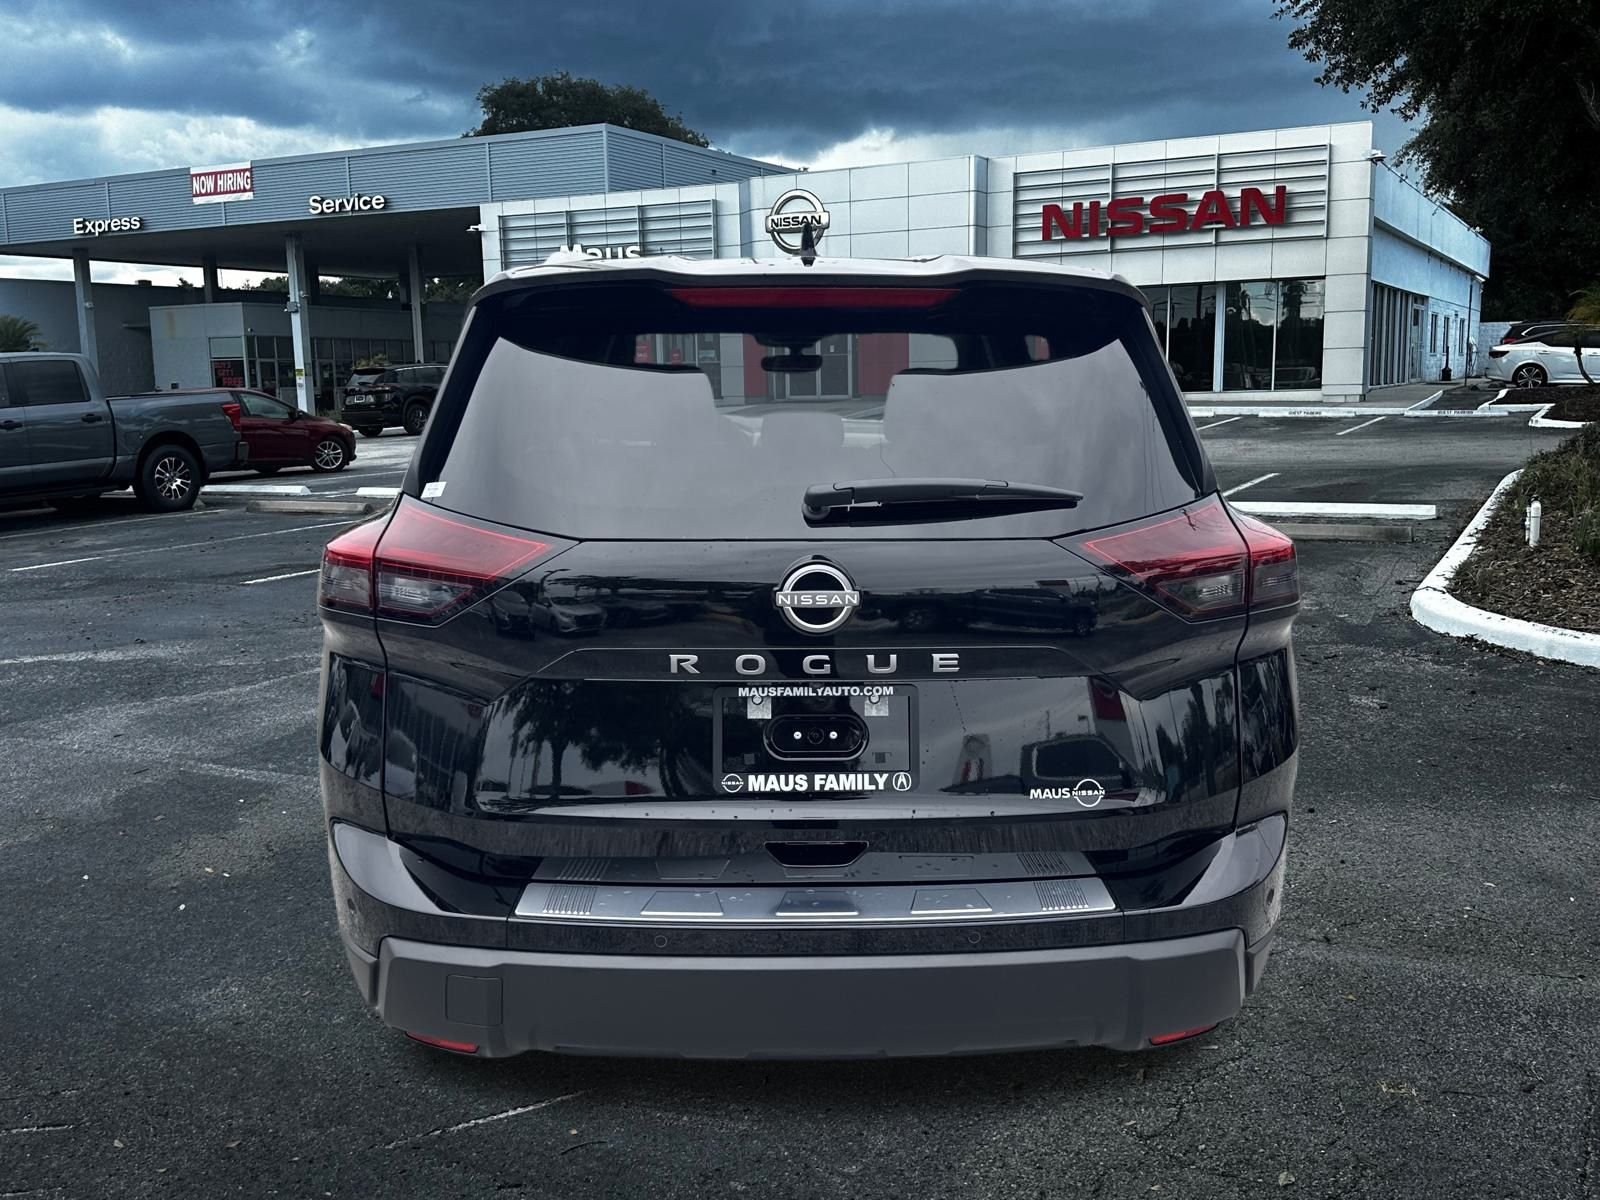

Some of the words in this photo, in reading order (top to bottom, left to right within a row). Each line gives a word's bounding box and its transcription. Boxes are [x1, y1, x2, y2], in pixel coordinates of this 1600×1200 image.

[192, 175, 215, 195] NOW
[216, 171, 250, 193] HIRING
[309, 193, 385, 214] Service
[1042, 185, 1287, 241] NISSAN
[73, 216, 141, 236] Express
[770, 214, 822, 228] NISSAN
[778, 594, 858, 605] NISSAN
[669, 653, 961, 675] ROGUE
[738, 686, 894, 697] MAUSFAMILYAUTO.COM
[748, 774, 808, 791] MAUS
[814, 773, 889, 791] FAMILY
[1029, 788, 1071, 799] MAUS
